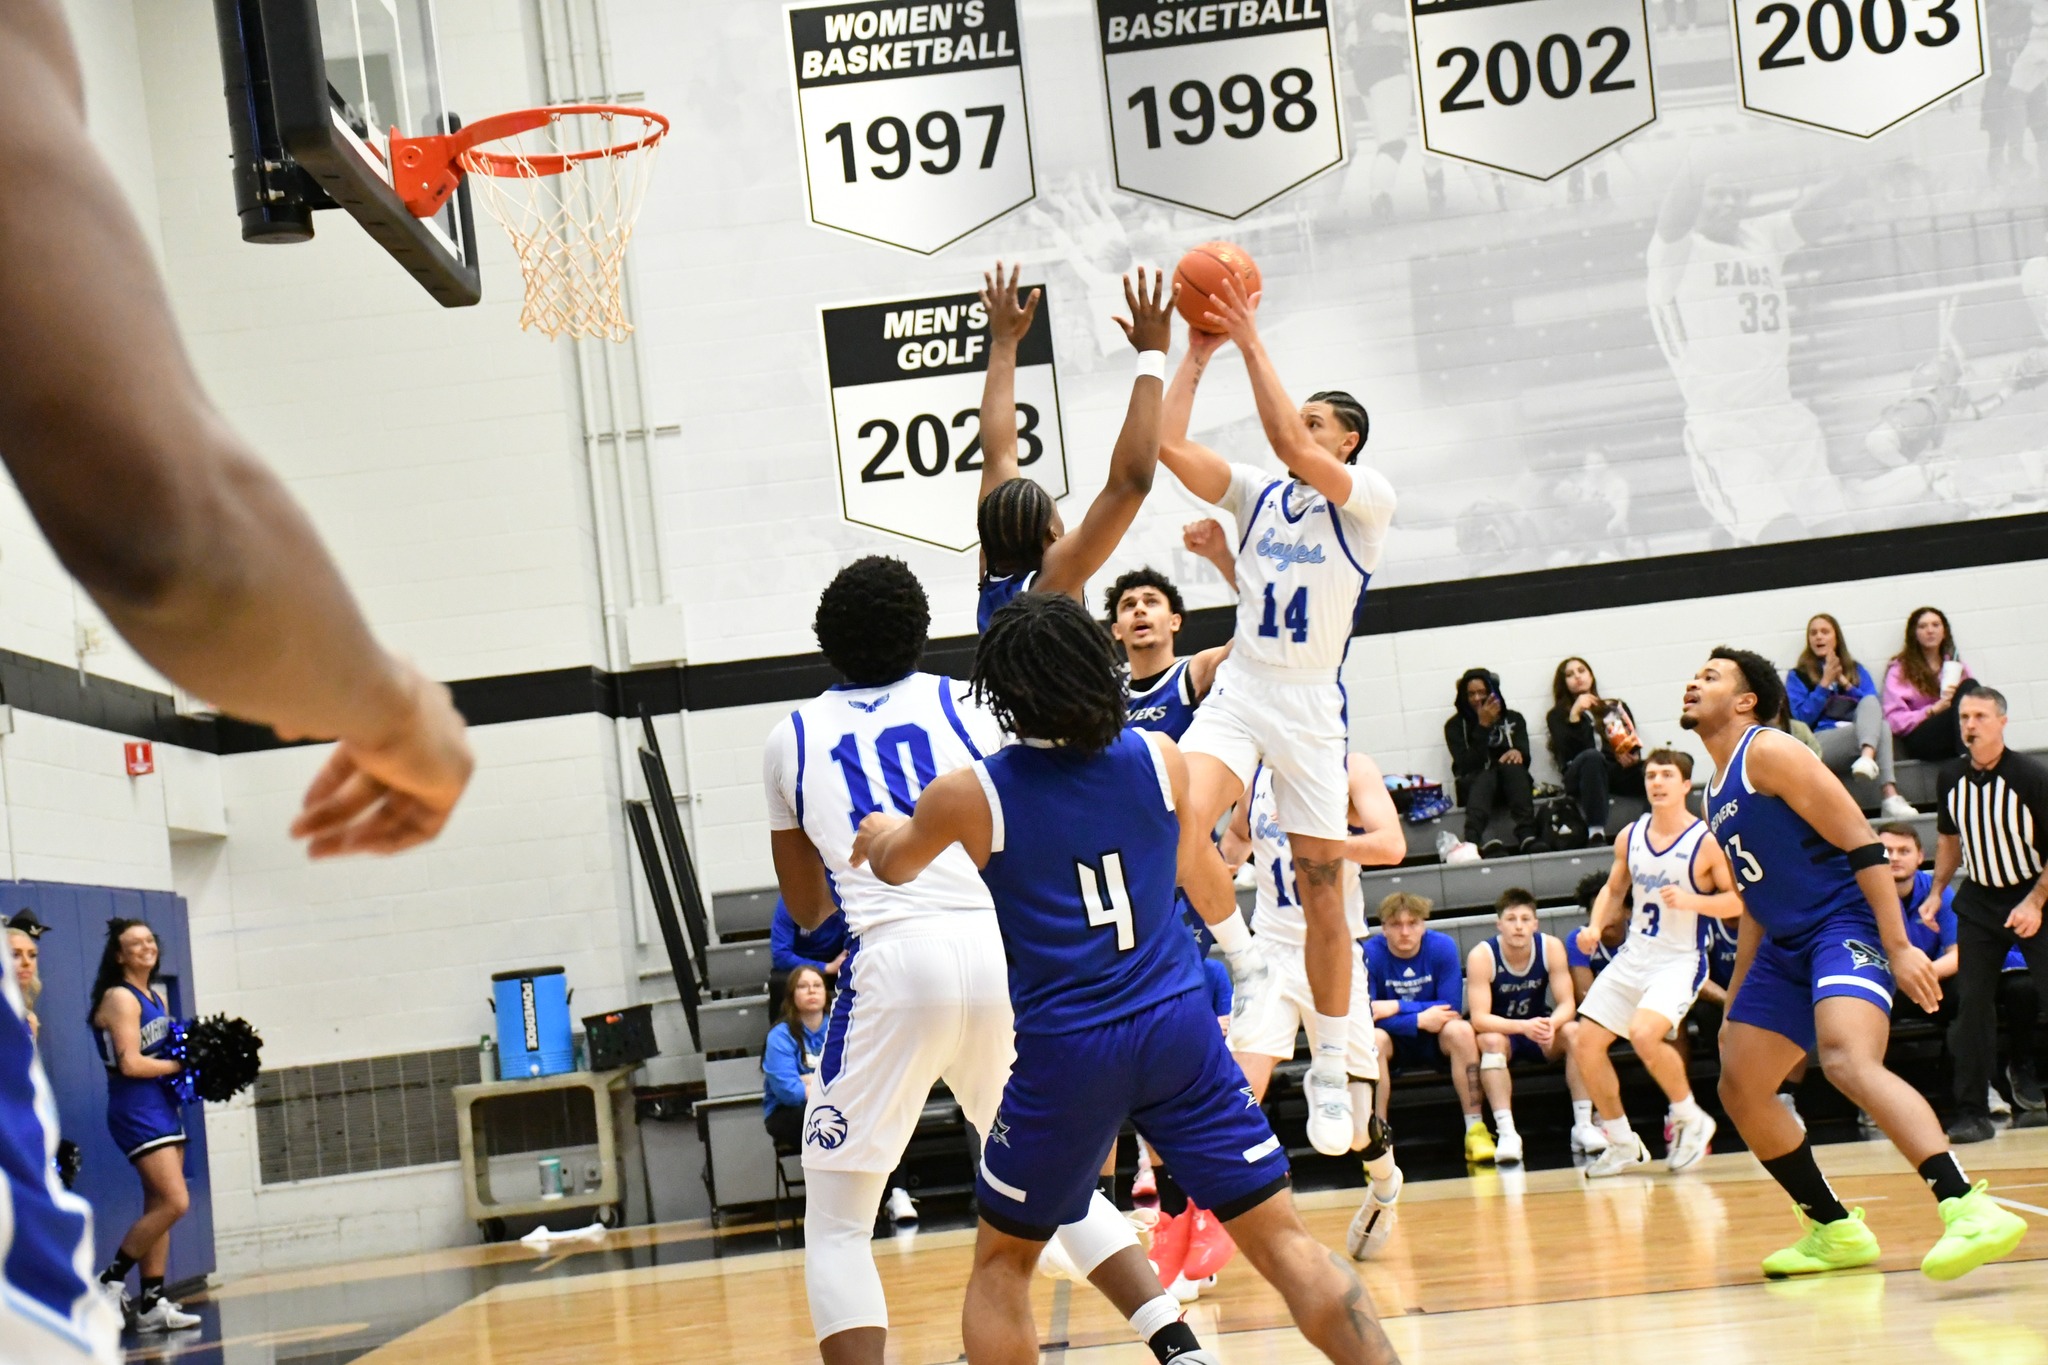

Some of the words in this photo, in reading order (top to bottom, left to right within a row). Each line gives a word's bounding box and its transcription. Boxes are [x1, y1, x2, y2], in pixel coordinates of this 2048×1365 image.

[825, 0, 985, 43] WOMEN'S
[1107, 0, 1322, 44] BASKETBALL
[1756, 0, 1960, 70] 2003
[802, 30, 1015, 79] BASKETBALL
[1437, 26, 1636, 113] 2002
[1127, 67, 1318, 149] 1998
[825, 104, 1005, 183] 1997
[883, 302, 989, 340] MEN'S
[1738, 292, 1780, 334] 33
[897, 335, 985, 370] GOLF
[1256, 527, 1326, 571] Eagles
[1258, 582, 1309, 643] 14
[1125, 706, 1167, 721] VERS
[830, 722, 938, 833] 10
[1076, 852, 1135, 951] 4
[1641, 902, 1660, 937] 3
[522, 982, 538, 1049] POWERADE
